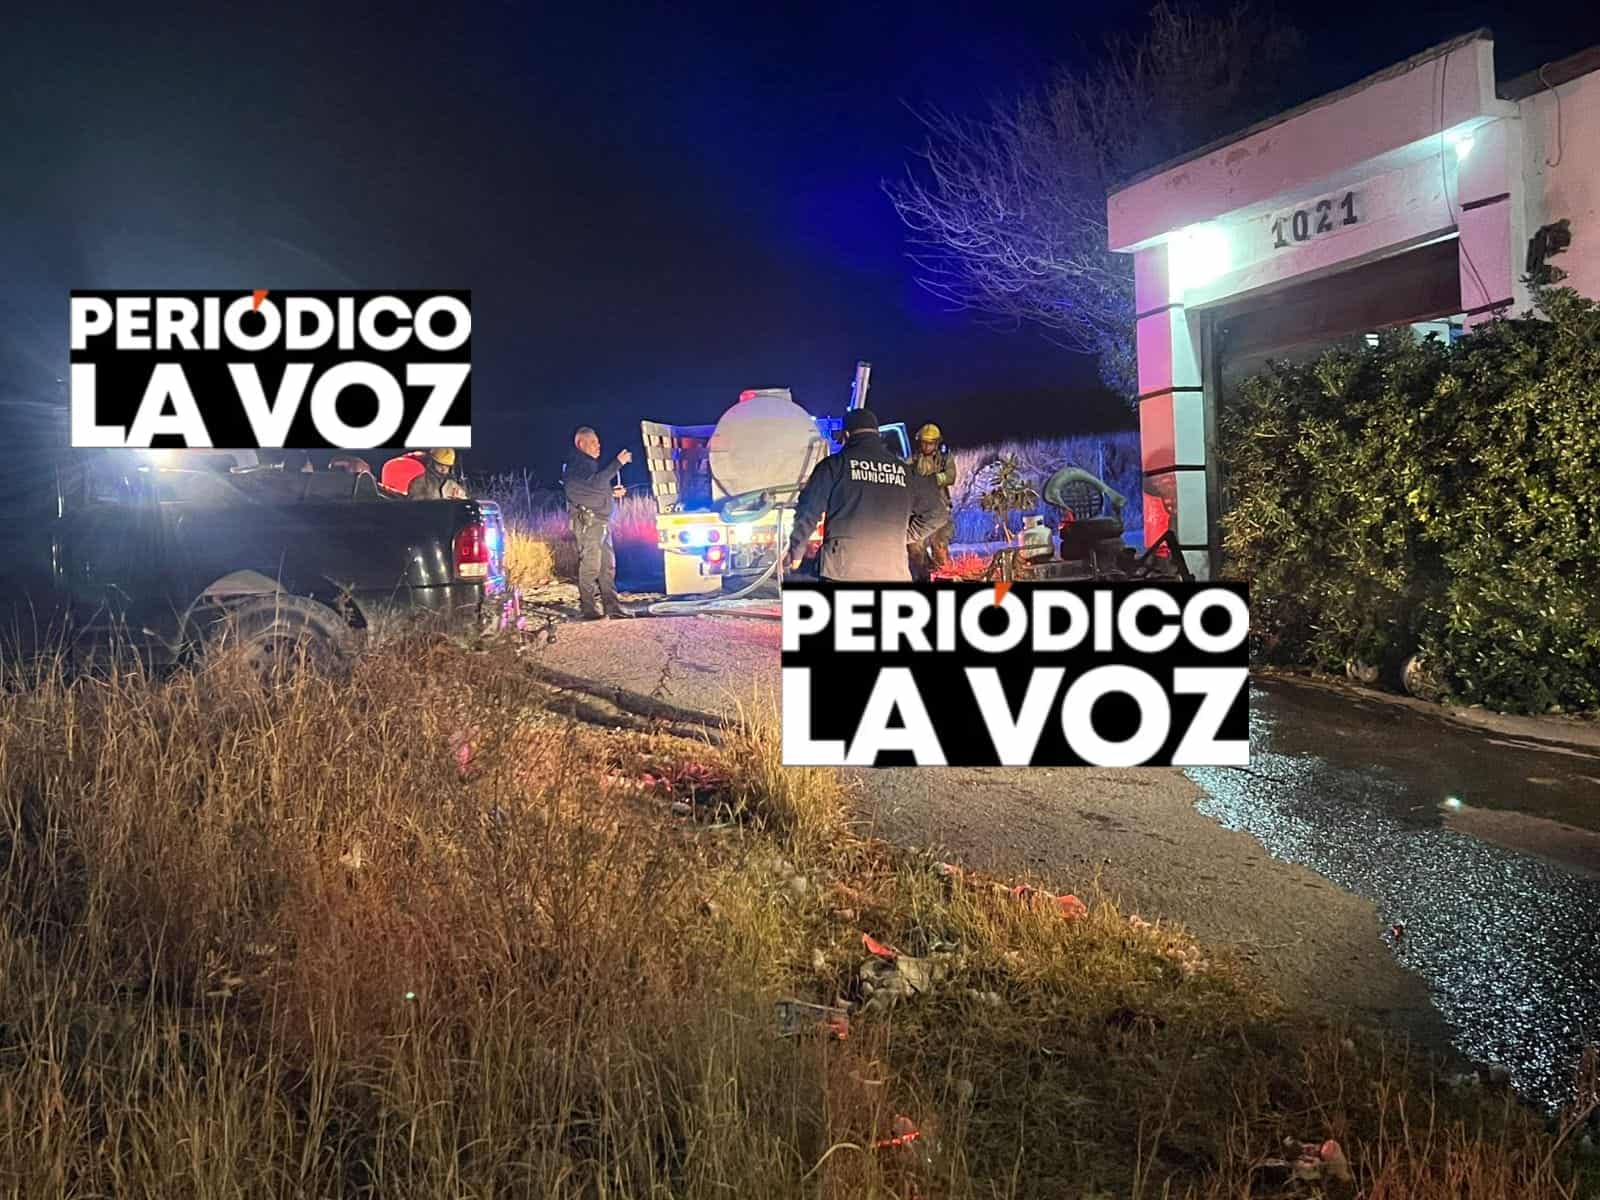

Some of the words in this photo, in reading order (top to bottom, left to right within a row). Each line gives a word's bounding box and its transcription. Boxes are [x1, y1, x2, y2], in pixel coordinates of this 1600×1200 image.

[1271, 191, 1358, 249] 1021
[850, 459, 906, 476] POLICIA
[851, 469, 906, 487] MUNICIPAL
